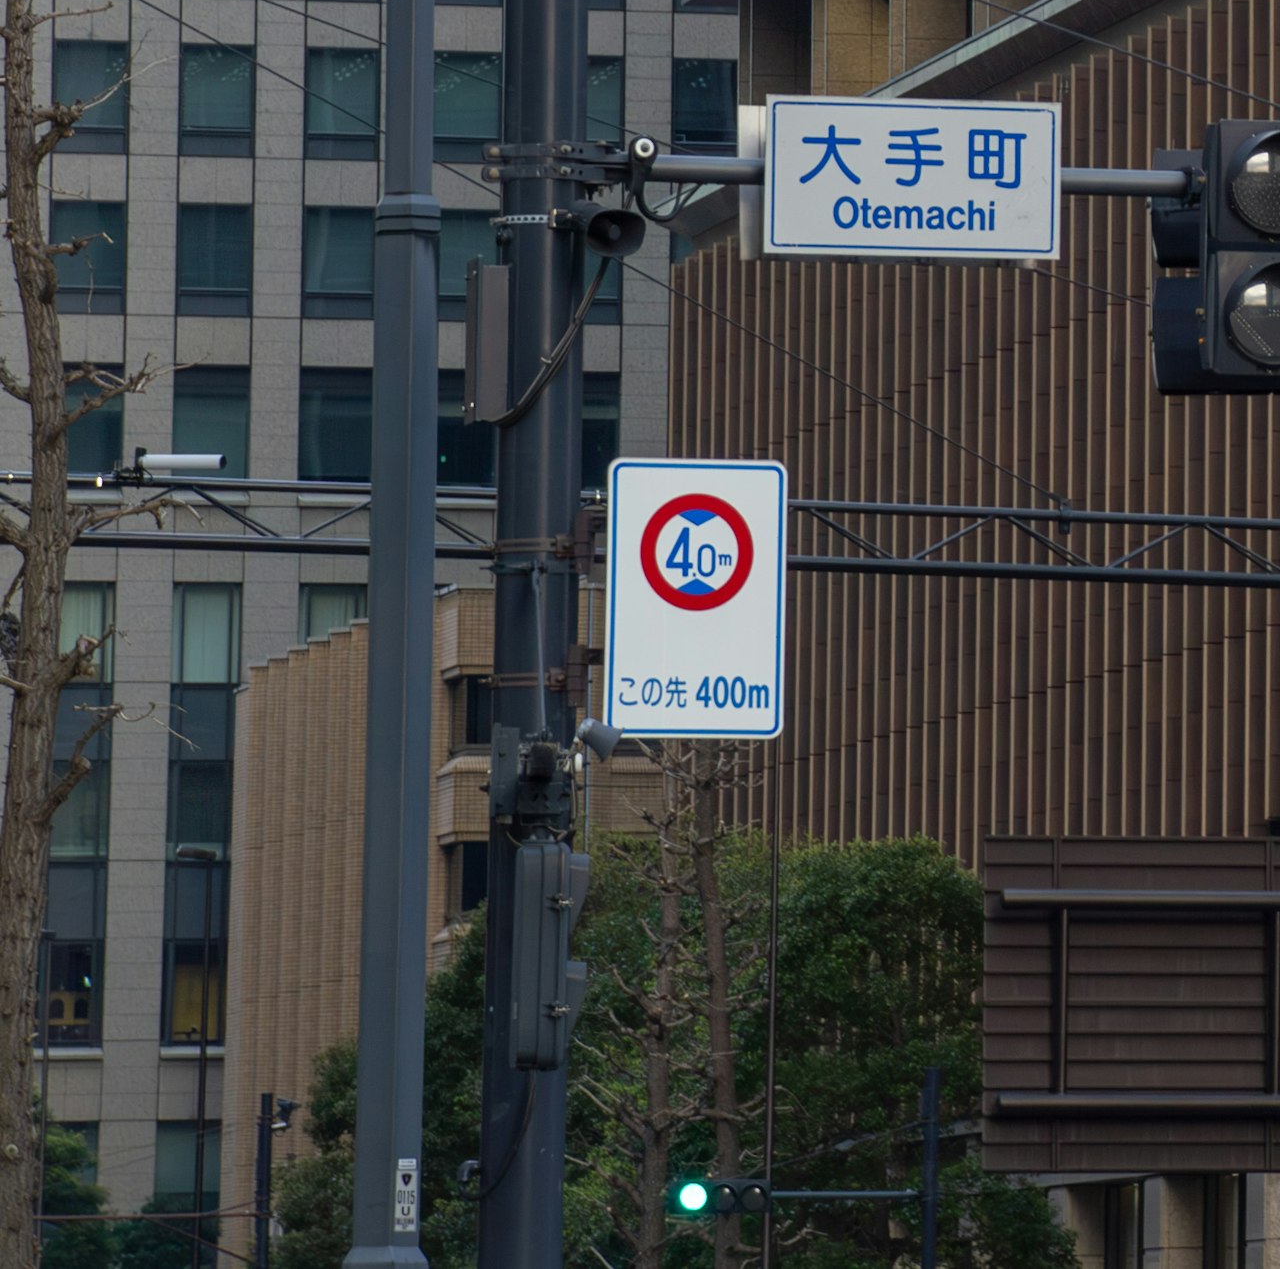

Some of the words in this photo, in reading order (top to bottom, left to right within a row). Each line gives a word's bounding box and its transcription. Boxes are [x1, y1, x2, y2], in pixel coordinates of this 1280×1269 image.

[799, 124, 1028, 189] 大手町
[832, 195, 996, 231] Otemachi
[665, 526, 733, 578] 4.0m
[618, 676, 688, 709] この先
[695, 675, 770, 709] 400m
[397, 1190, 416, 1205] 0115
